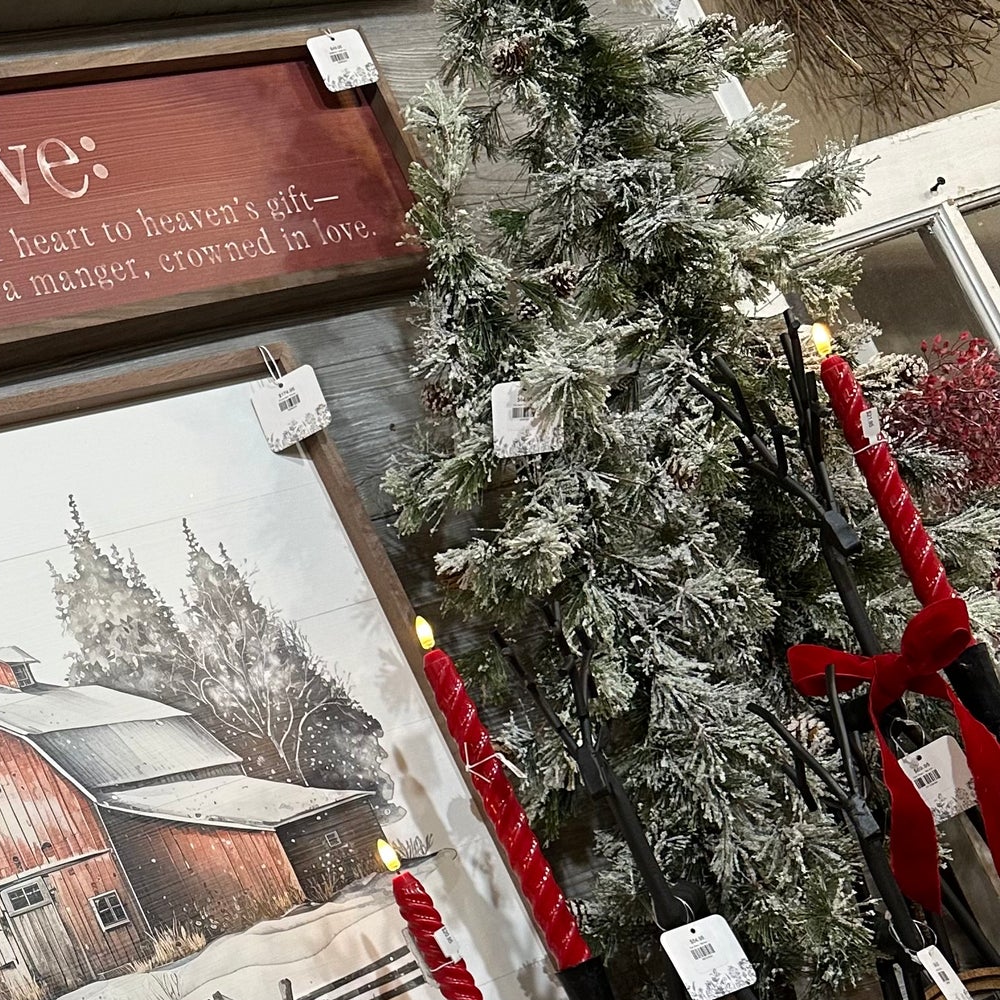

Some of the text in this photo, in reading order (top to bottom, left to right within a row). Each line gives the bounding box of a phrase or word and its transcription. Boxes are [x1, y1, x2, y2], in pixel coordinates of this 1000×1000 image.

[2, 279, 22, 302] a
[29, 256, 151, 297] manger,
[159, 227, 277, 275] crowned
[280, 227, 313, 252] in
[312, 217, 377, 247] love.
[9, 228, 95, 260] heart
[102, 220, 132, 244] to
[136, 197, 260, 238] heaven's
